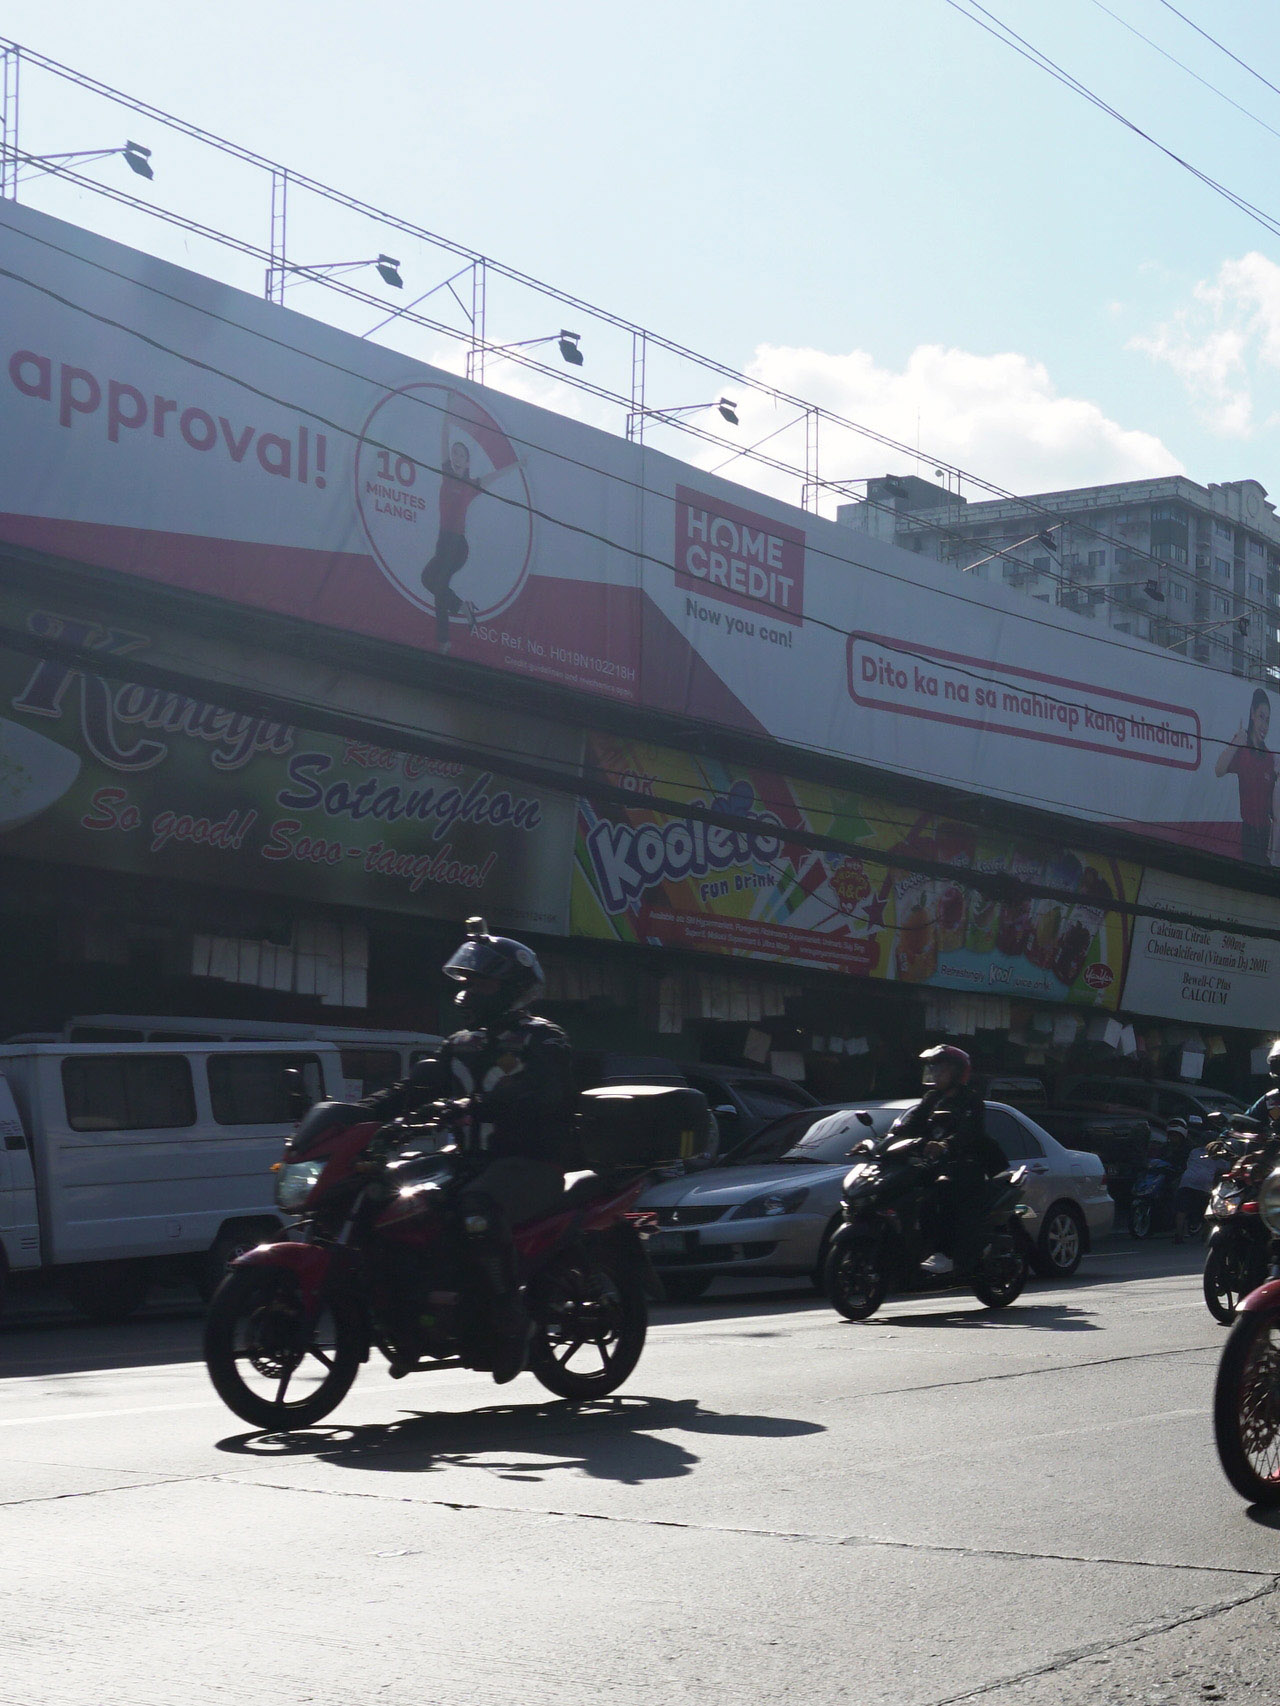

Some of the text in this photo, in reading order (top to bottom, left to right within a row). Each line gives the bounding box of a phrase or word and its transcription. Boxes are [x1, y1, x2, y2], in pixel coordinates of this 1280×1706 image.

[9, 349, 328, 490] approval!
[376, 450, 416, 488] 10
[366, 481, 426, 511] MINUTES
[375, 499, 417, 523] LANG!
[687, 506, 783, 572] HOME
[686, 545, 794, 607] CREDIT
[470, 626, 498, 643] ASC
[502, 632, 524, 651] Ref.
[528, 640, 547, 657] No.
[686, 598, 793, 648] Now you can!
[861, 654, 1195, 750] Dito ka na sa mahirap kang hindian.
[277, 753, 542, 842] Sotanghon
[81, 786, 498, 893] So good! Sooo-tanghon!
[587, 800, 783, 916] Koolers
[1147, 939, 1204, 963] Cholecalciferol
[1150, 920, 1183, 940] Calcium
[1185, 926, 1211, 946] Citrate
[1181, 986, 1229, 1005] CALCIUM
[1182, 972, 1232, 991] Bewell-C Plus
